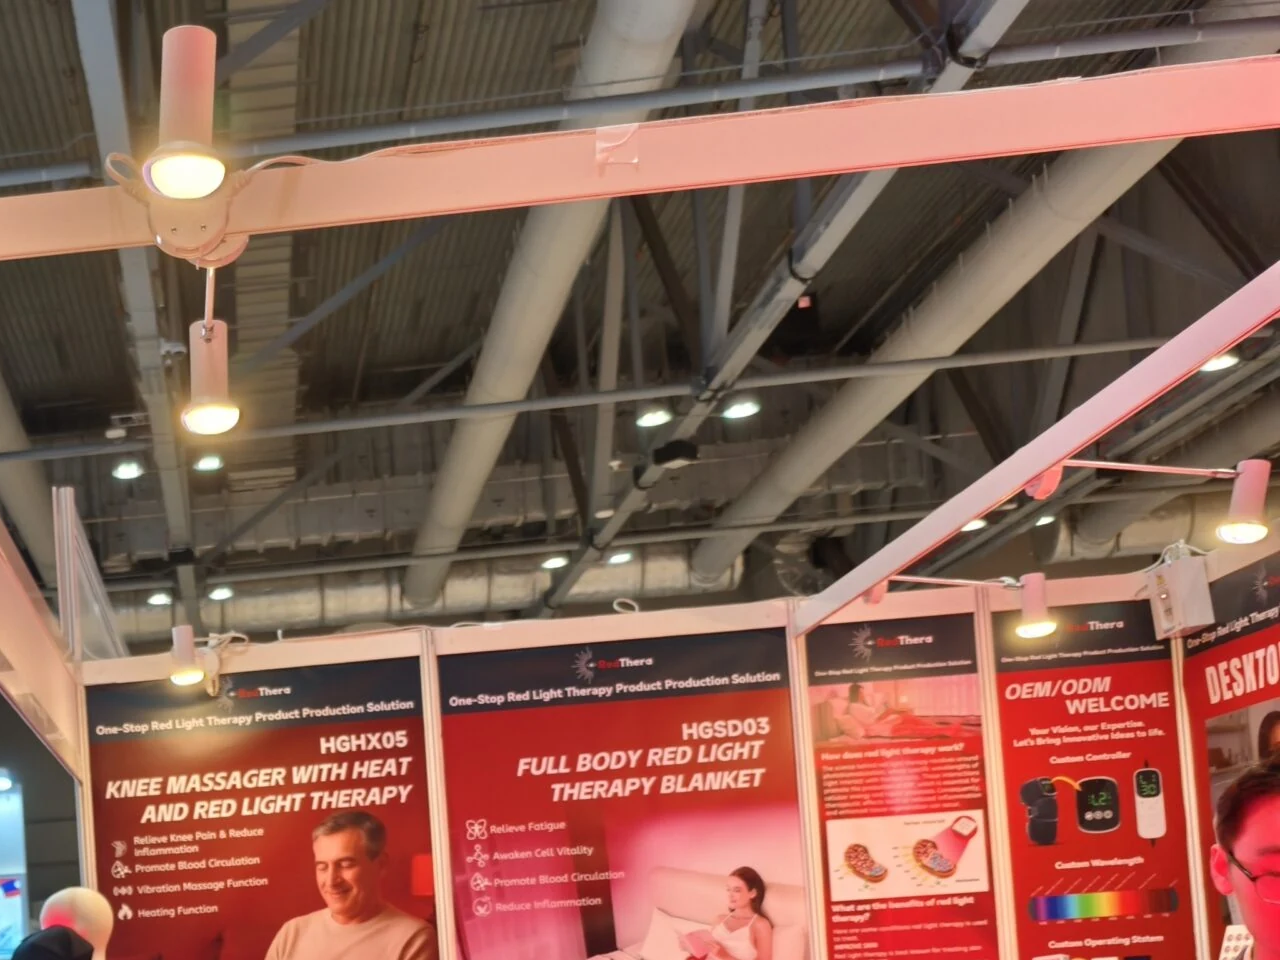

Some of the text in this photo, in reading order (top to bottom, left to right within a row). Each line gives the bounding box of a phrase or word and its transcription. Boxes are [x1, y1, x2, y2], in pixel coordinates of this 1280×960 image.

[1205, 641, 1280, 704] DESKTO
[449, 671, 781, 707] One-Stop Red Light Therapy Product Production Solution
[1004, 676, 1111, 700] OEM/ODM
[1066, 692, 1169, 715] WELCOME
[96, 700, 414, 736] One-Stop Red Light Therapy Product Production Solution
[681, 717, 770, 740] HGSD03
[319, 730, 408, 754] HGHX05
[517, 740, 765, 776] FULL BODY RED LIGHT
[105, 757, 413, 799] KNEE MASSAGER WITH HEAT
[551, 768, 766, 802] THERAPY BLANKET
[140, 784, 413, 824] AND RED LIGHT THERAPY
[134, 827, 264, 845] Relieve Knee Pain & Reduce
[490, 821, 566, 834] Relieve Fatigue
[134, 845, 199, 857] Inflammation
[492, 846, 594, 861] Awaken Cell Vitality
[135, 856, 260, 873] Promote Blood Circulation
[137, 877, 268, 894] Vibration Massage Function
[494, 870, 625, 887] Promote Blood Circulation
[138, 904, 218, 918] Heating Function
[495, 896, 602, 912] Reduce Inflammation
